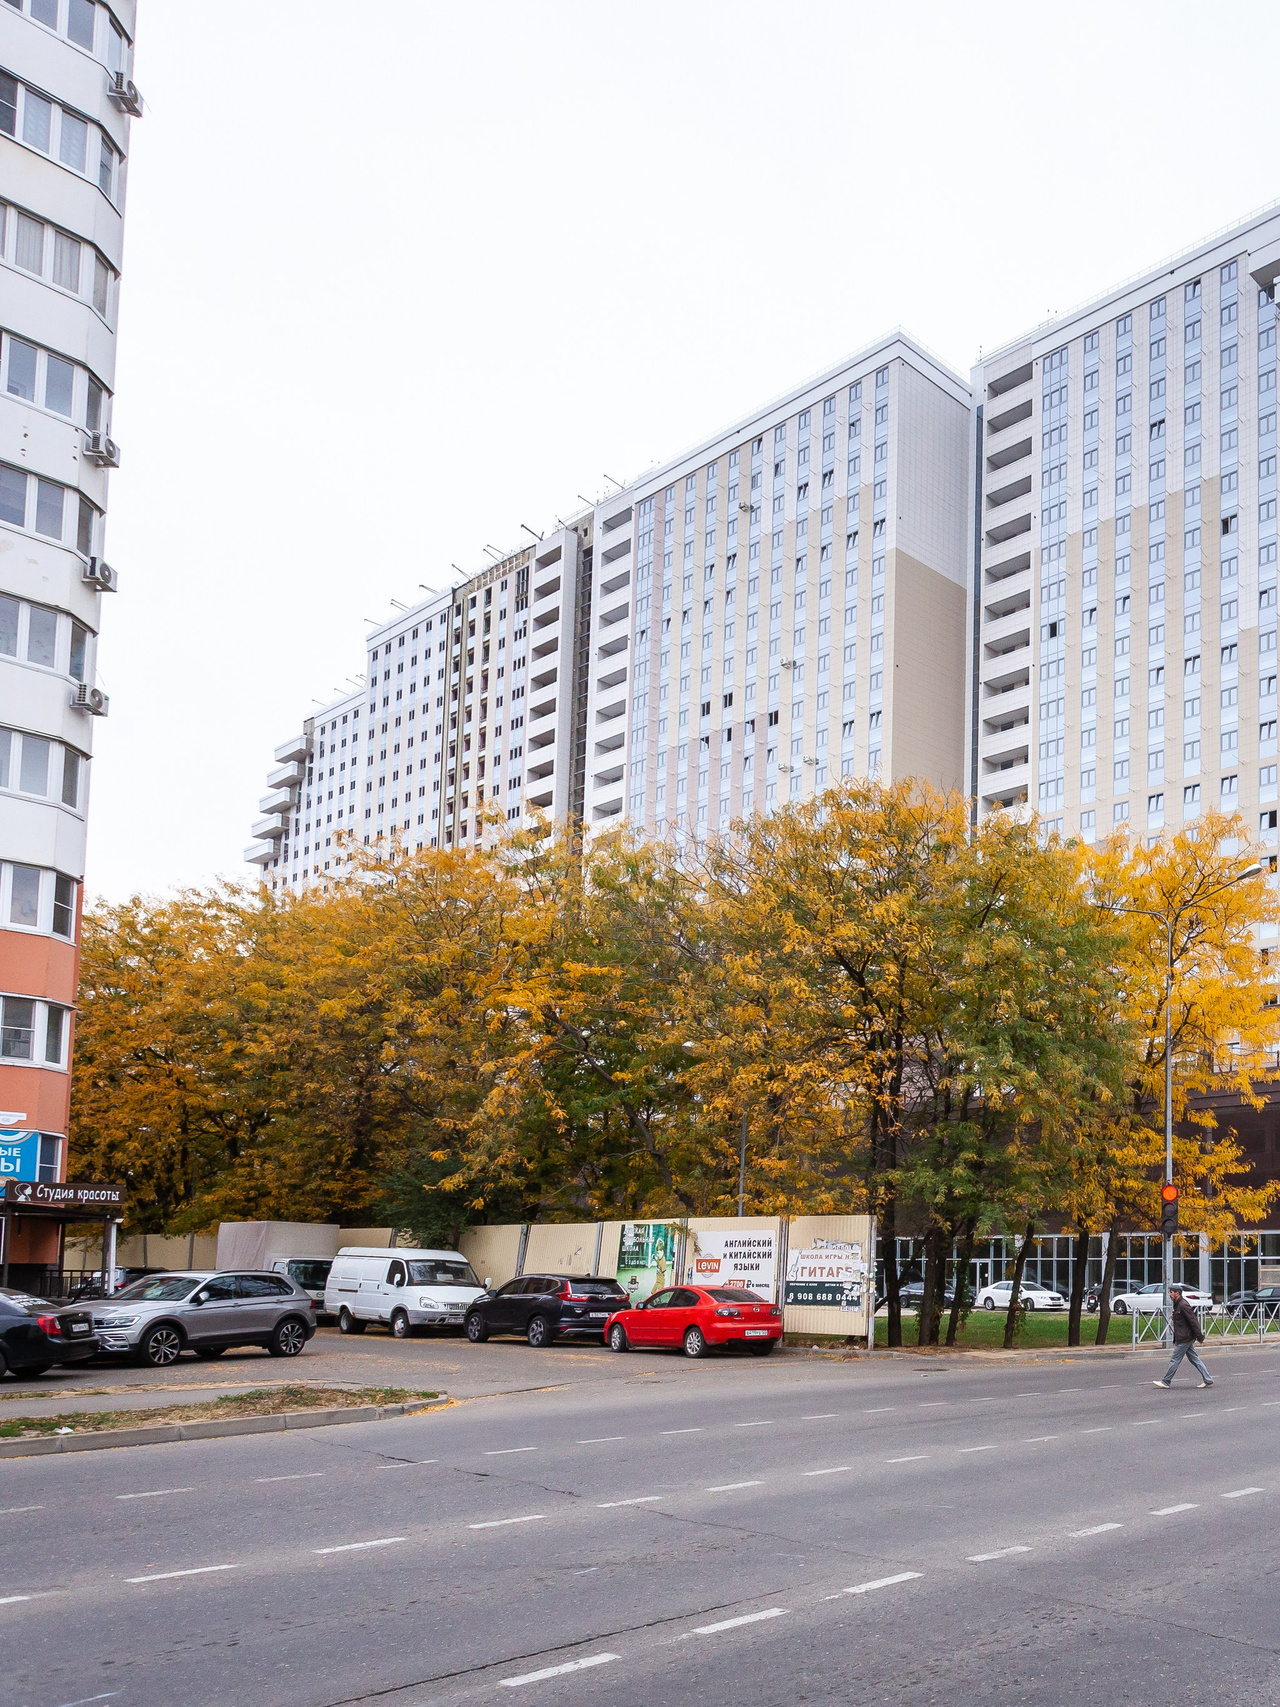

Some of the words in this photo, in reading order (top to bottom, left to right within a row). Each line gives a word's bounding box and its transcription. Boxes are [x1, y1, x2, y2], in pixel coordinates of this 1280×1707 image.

[36, 1184, 74, 1202] Студия
[77, 1189, 120, 1204] красоты
[724, 1237, 772, 1248] АНГЛИЙСКИЙ
[728, 1249, 772, 1260] КИТАЙСКИЙ
[733, 1262, 760, 1271] ЯЗЫКИ
[789, 1292, 794, 1300] 8
[797, 1292, 813, 1300] 908
[816, 1293, 832, 1301] 688
